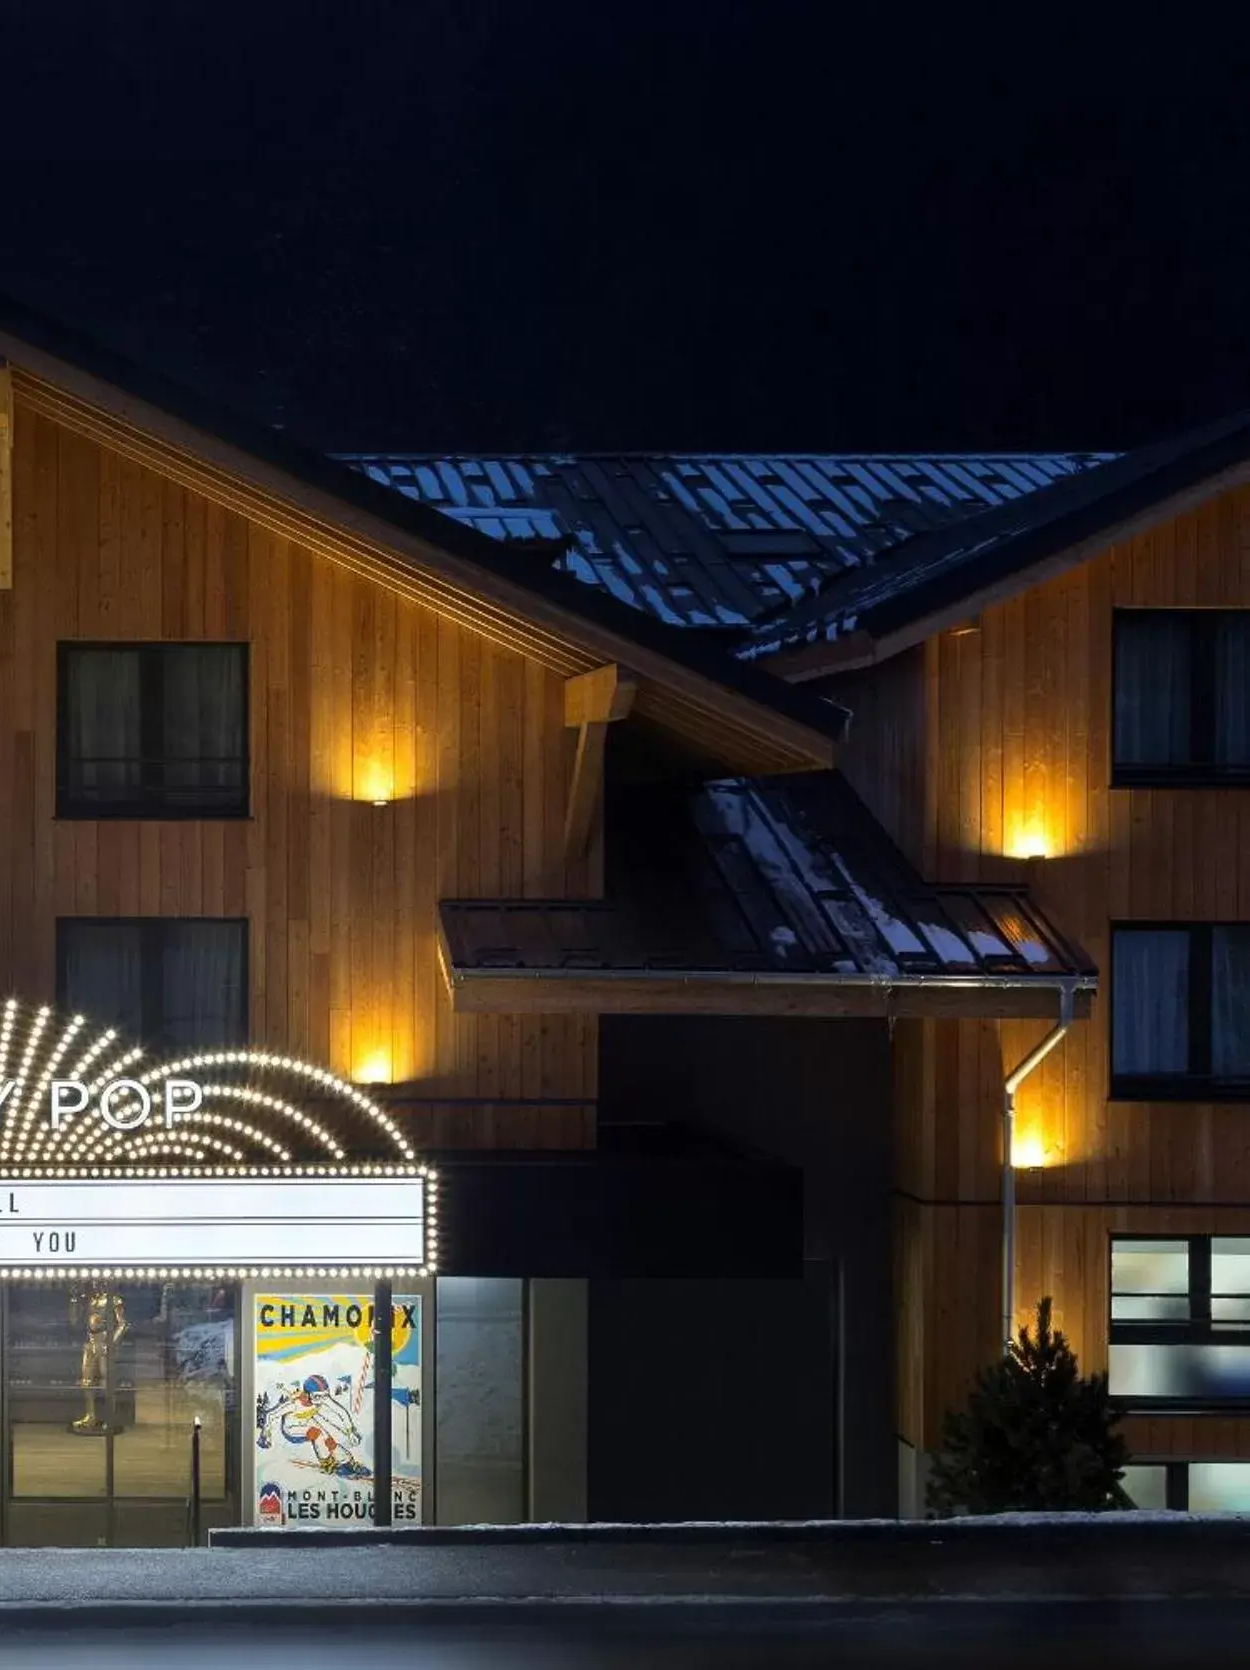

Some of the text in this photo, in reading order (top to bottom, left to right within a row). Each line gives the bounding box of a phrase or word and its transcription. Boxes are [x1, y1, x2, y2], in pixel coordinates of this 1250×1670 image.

[51, 1079, 203, 1131] POP
[33, 1231, 76, 1253] YOU
[288, 1490, 417, 1502] MONT-BLNC
[287, 1503, 416, 1519] LES HOUCES
